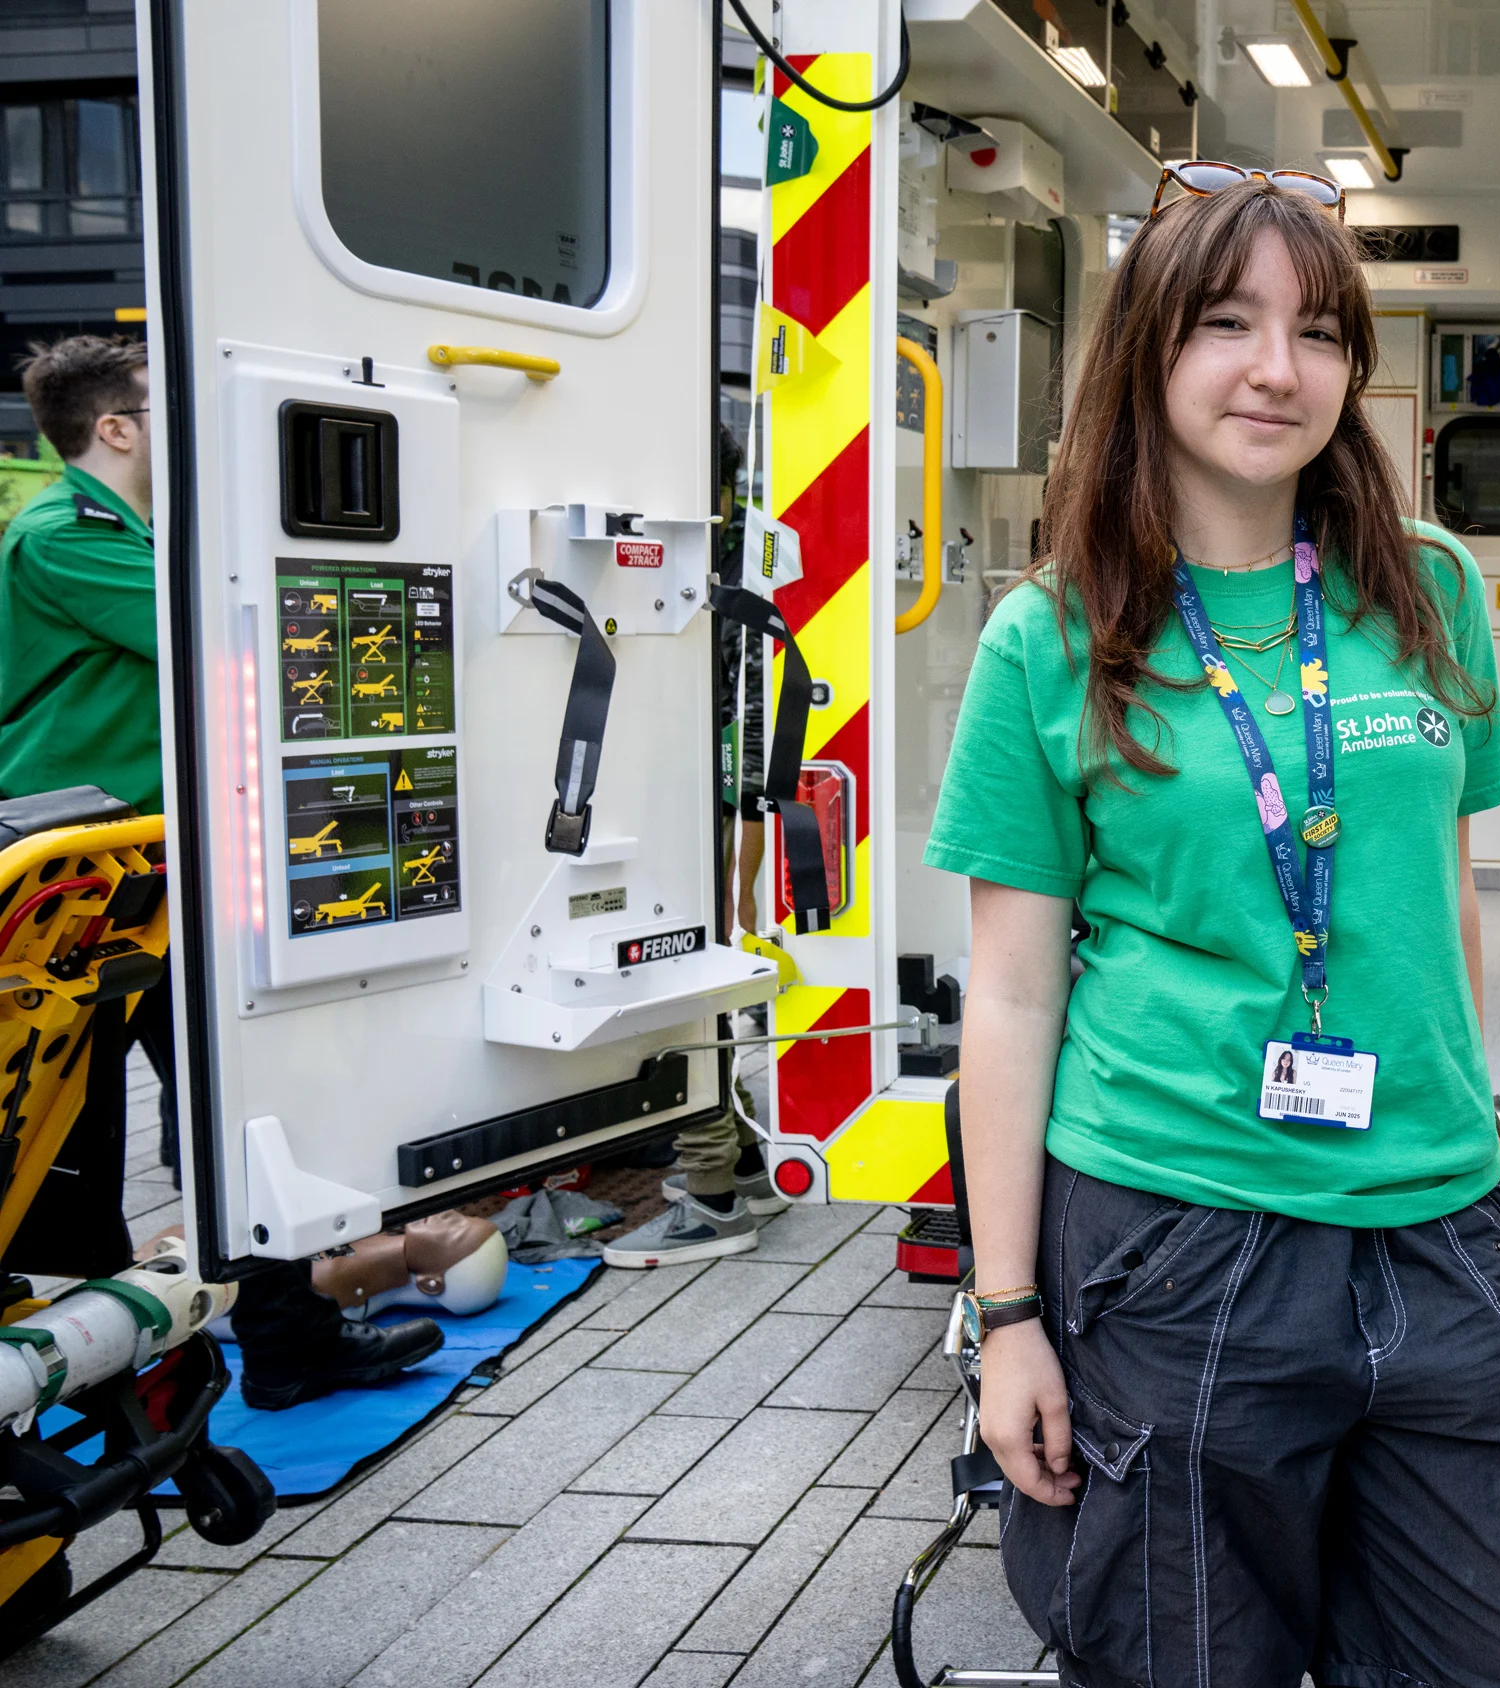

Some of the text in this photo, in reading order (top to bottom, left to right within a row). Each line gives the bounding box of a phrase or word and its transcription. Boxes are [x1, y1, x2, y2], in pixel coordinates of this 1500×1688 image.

[779, 140, 788, 159] John
[619, 544, 660, 556] COMPACT
[763, 532, 774, 578] STUDENT
[628, 555, 660, 566] 2TRACK
[341, 566, 377, 574] OPERATIONS
[422, 567, 451, 578] stryker
[1187, 608, 1210, 650] Queen Mary
[1330, 695, 1358, 706] Proud
[1370, 691, 1382, 699] be
[1336, 712, 1412, 740] St John
[1313, 712, 1324, 760] Queen Mary
[1341, 733, 1416, 754] Ambulance
[426, 748, 454, 759] stryker
[1240, 723, 1262, 768] Queen Mary
[310, 756, 364, 766] MANUAL OPERATIONS
[409, 800, 422, 808] Other
[1304, 823, 1324, 839] FIRST
[1324, 816, 1337, 828] AID
[1314, 826, 1334, 840] SOCIETY
[1282, 862, 1300, 912] Queen Mary
[1313, 856, 1326, 905] Queen Mary
[642, 932, 696, 960] FERNO
[1322, 1057, 1363, 1070] Queen Mary
[1270, 1086, 1306, 1094] KAPUSHESKY
